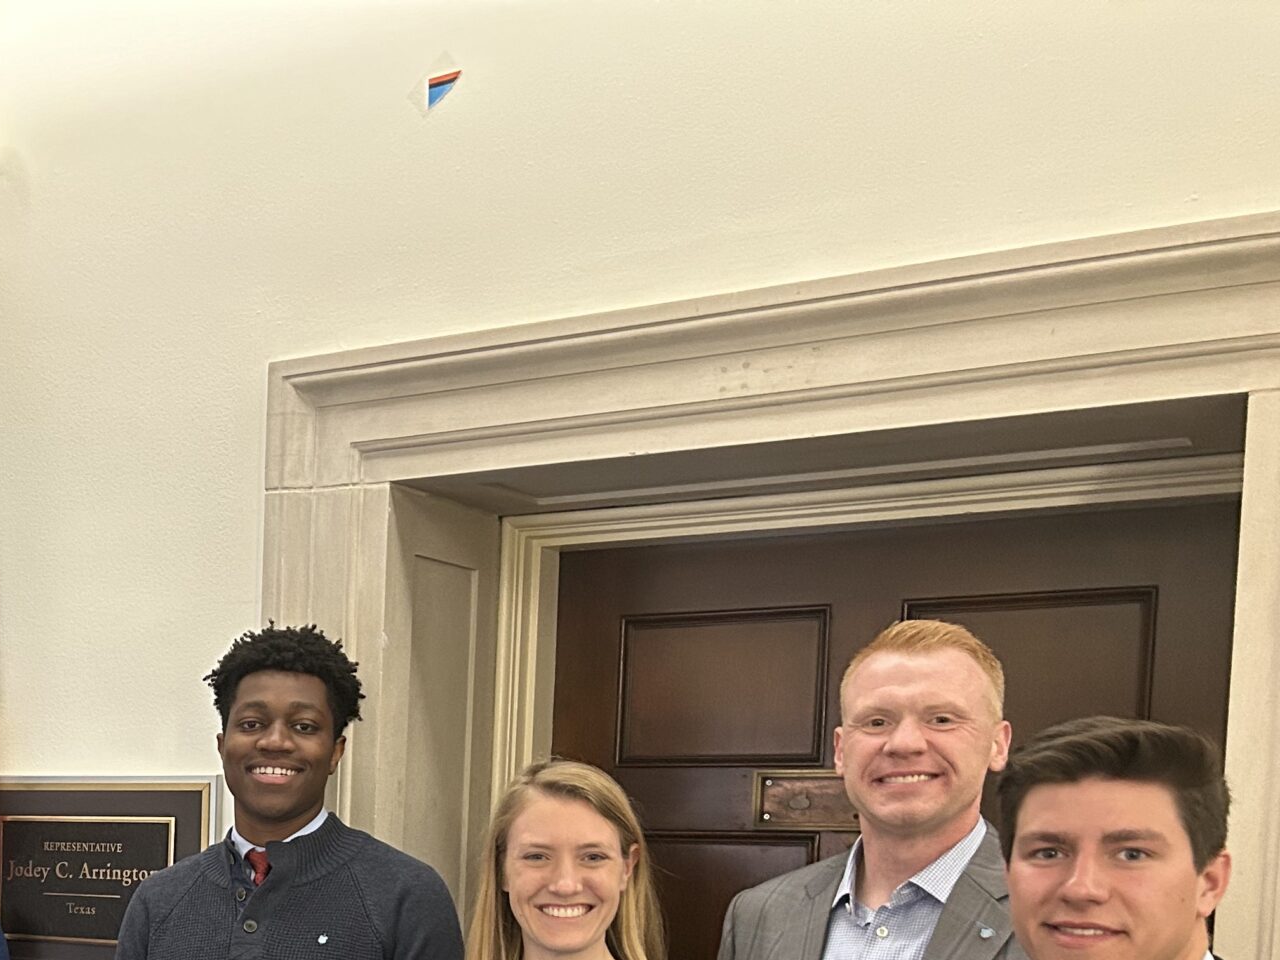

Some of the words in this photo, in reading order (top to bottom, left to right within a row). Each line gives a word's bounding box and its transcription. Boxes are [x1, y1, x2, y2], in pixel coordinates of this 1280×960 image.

[43, 841, 123, 853] REPRESENTATIVE
[7, 860, 51, 883] Jodey
[55, 861, 73, 879] C.
[66, 902, 96, 915] Texas
